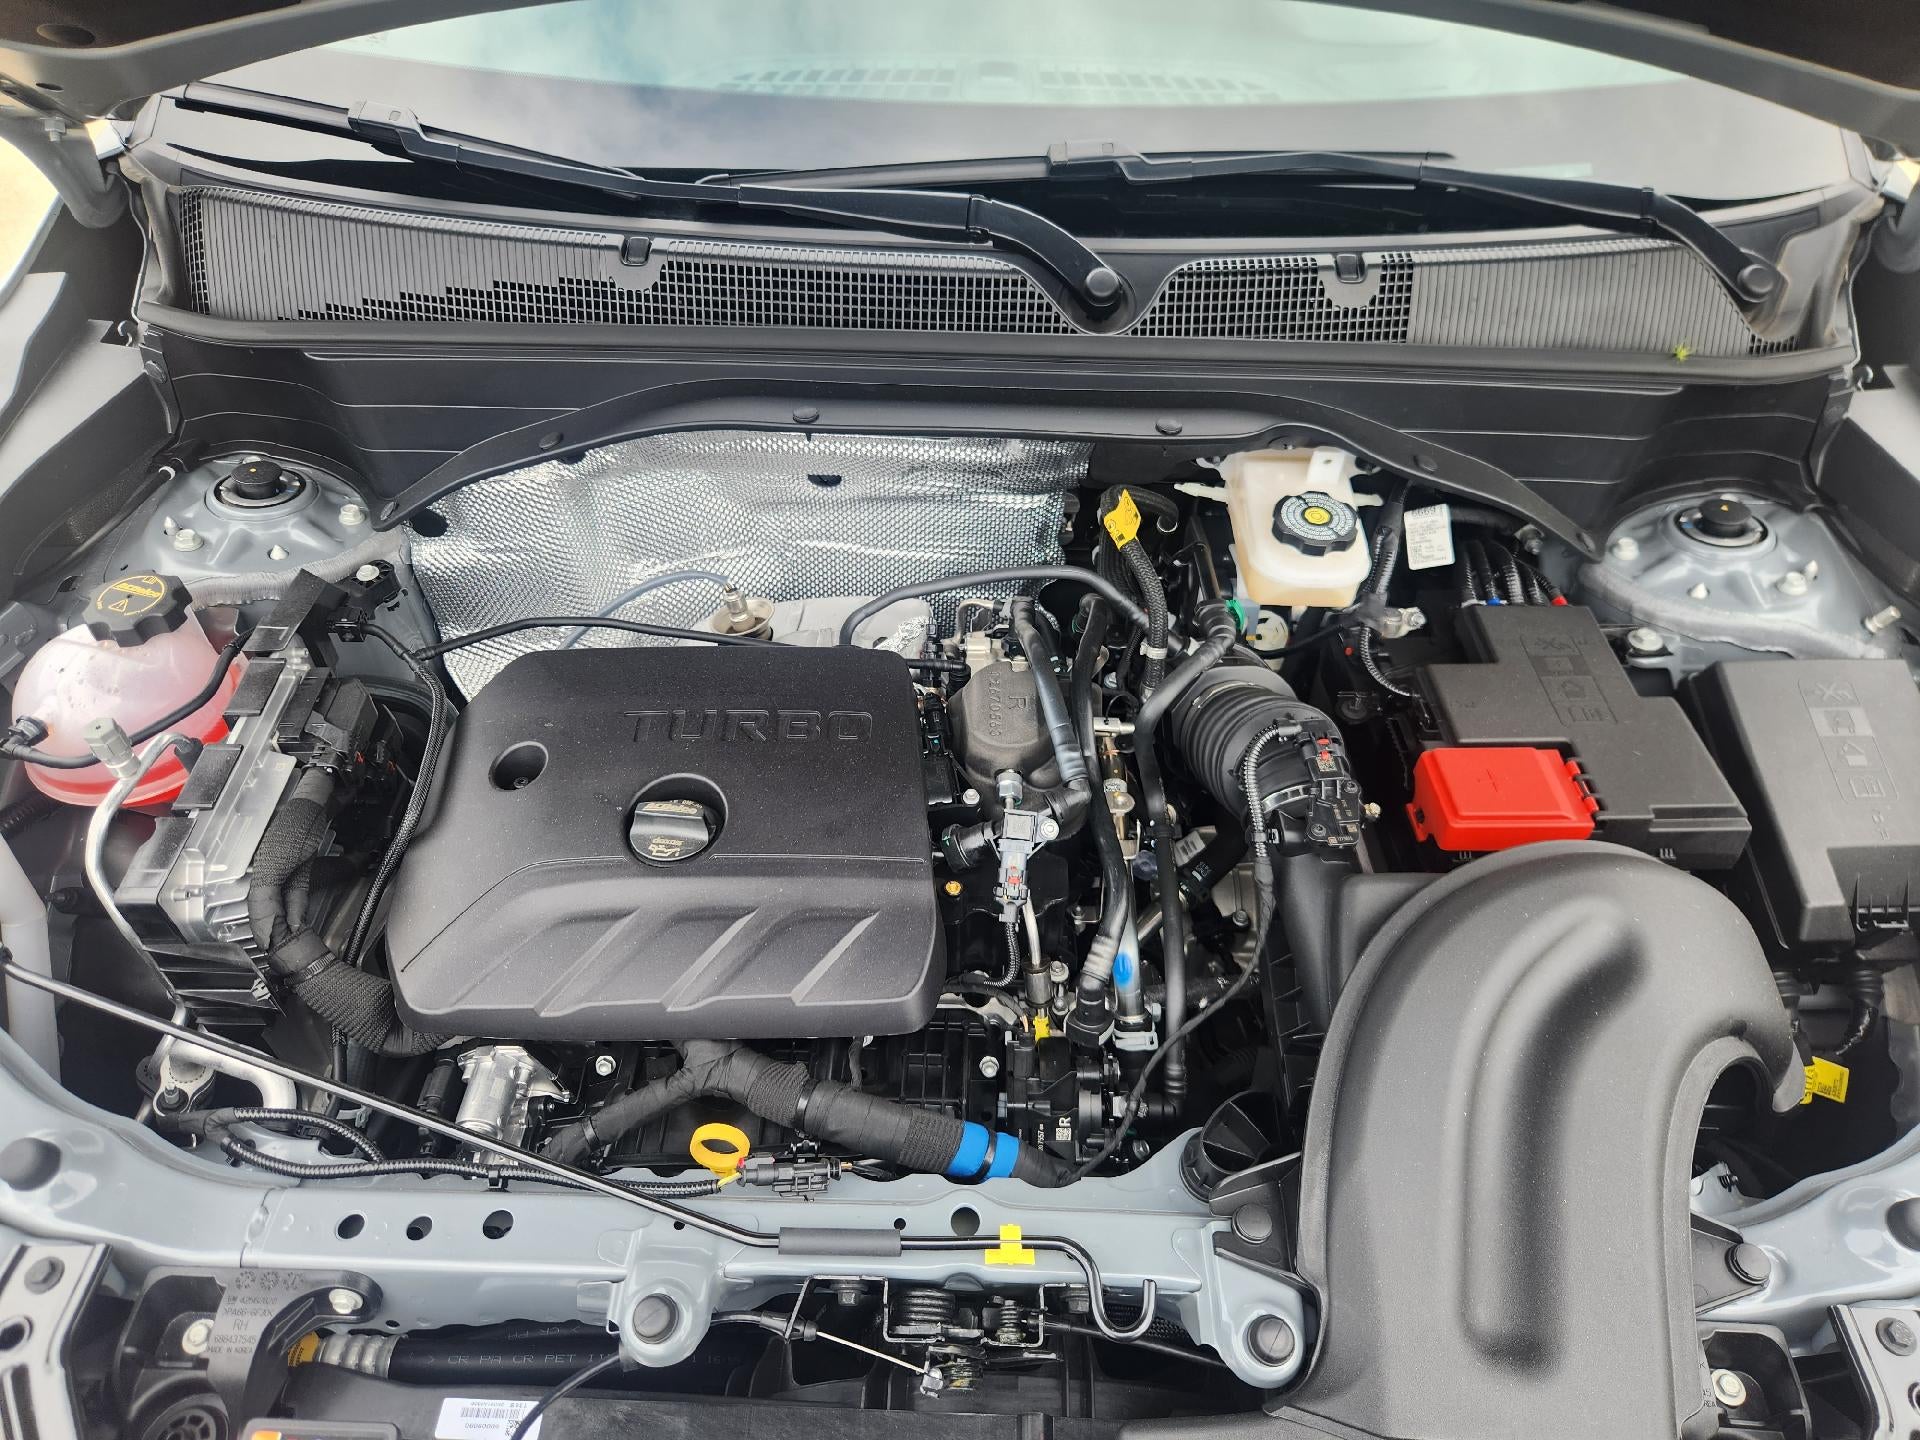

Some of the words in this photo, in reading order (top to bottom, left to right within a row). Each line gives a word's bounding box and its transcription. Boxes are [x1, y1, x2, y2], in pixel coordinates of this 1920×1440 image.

[1008, 695, 1028, 710] R
[624, 709, 873, 742] TURBO
[1059, 1116, 1071, 1127] R
[233, 1319, 249, 1331] RH
[544, 1354, 576, 1364] PET
